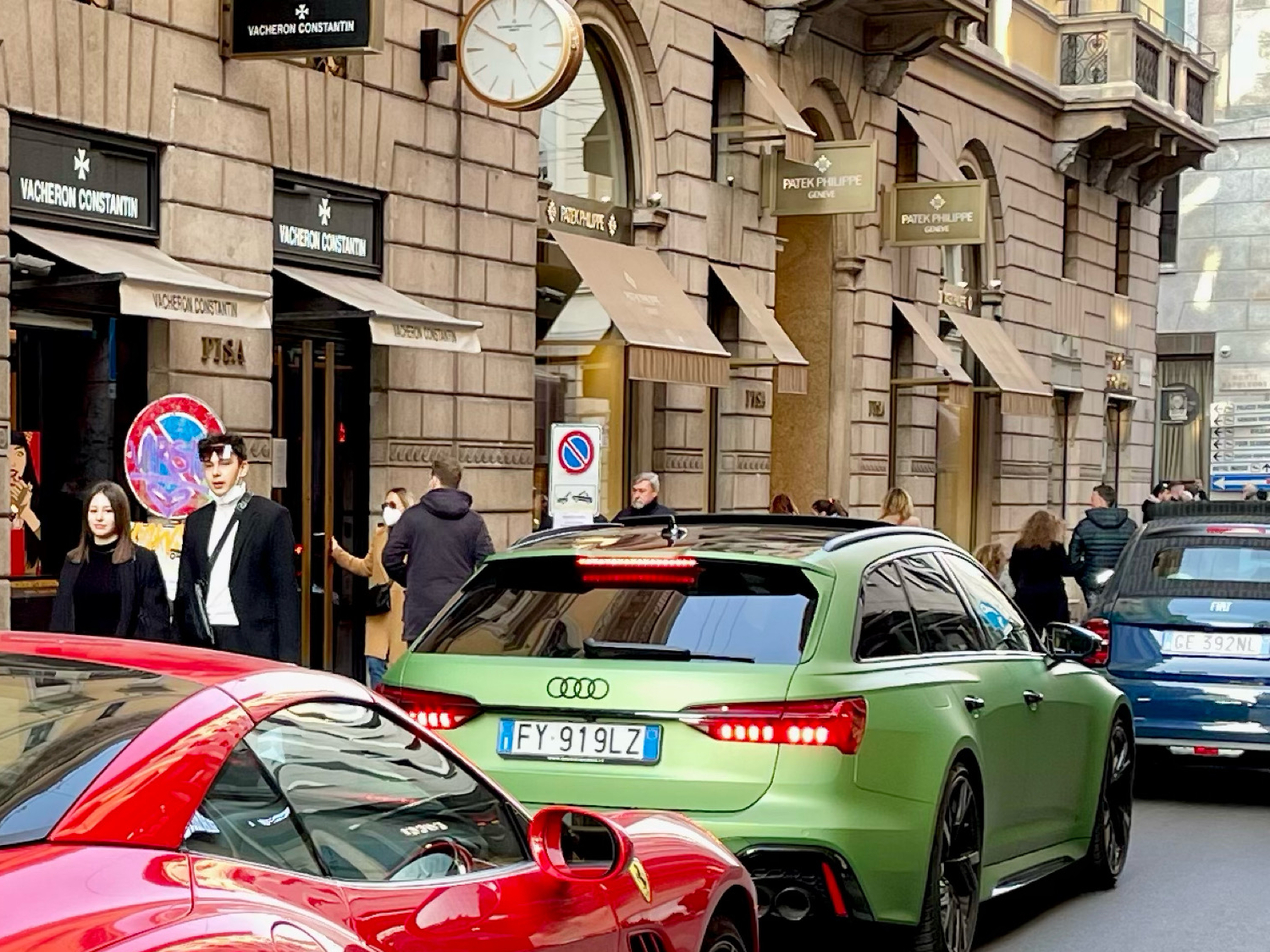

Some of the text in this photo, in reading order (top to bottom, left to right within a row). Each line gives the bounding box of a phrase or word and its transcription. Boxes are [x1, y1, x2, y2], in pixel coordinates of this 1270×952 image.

[248, 20, 355, 36] VACHERON CONSTANTIN
[783, 174, 863, 190] PATEK PHILIPPE
[20, 177, 139, 219] VACHERON CONSTANTIN
[901, 211, 974, 224] PATEK PHILIPPE
[279, 224, 367, 257] VACHERON CONSTANTIN
[152, 293, 238, 318] VACHERON CONSTANTIN
[201, 336, 247, 365] PISA
[1210, 602, 1233, 612] FIAT
[1174, 634, 1255, 652] GE 392NL
[517, 723, 642, 755] FY 919LZ
